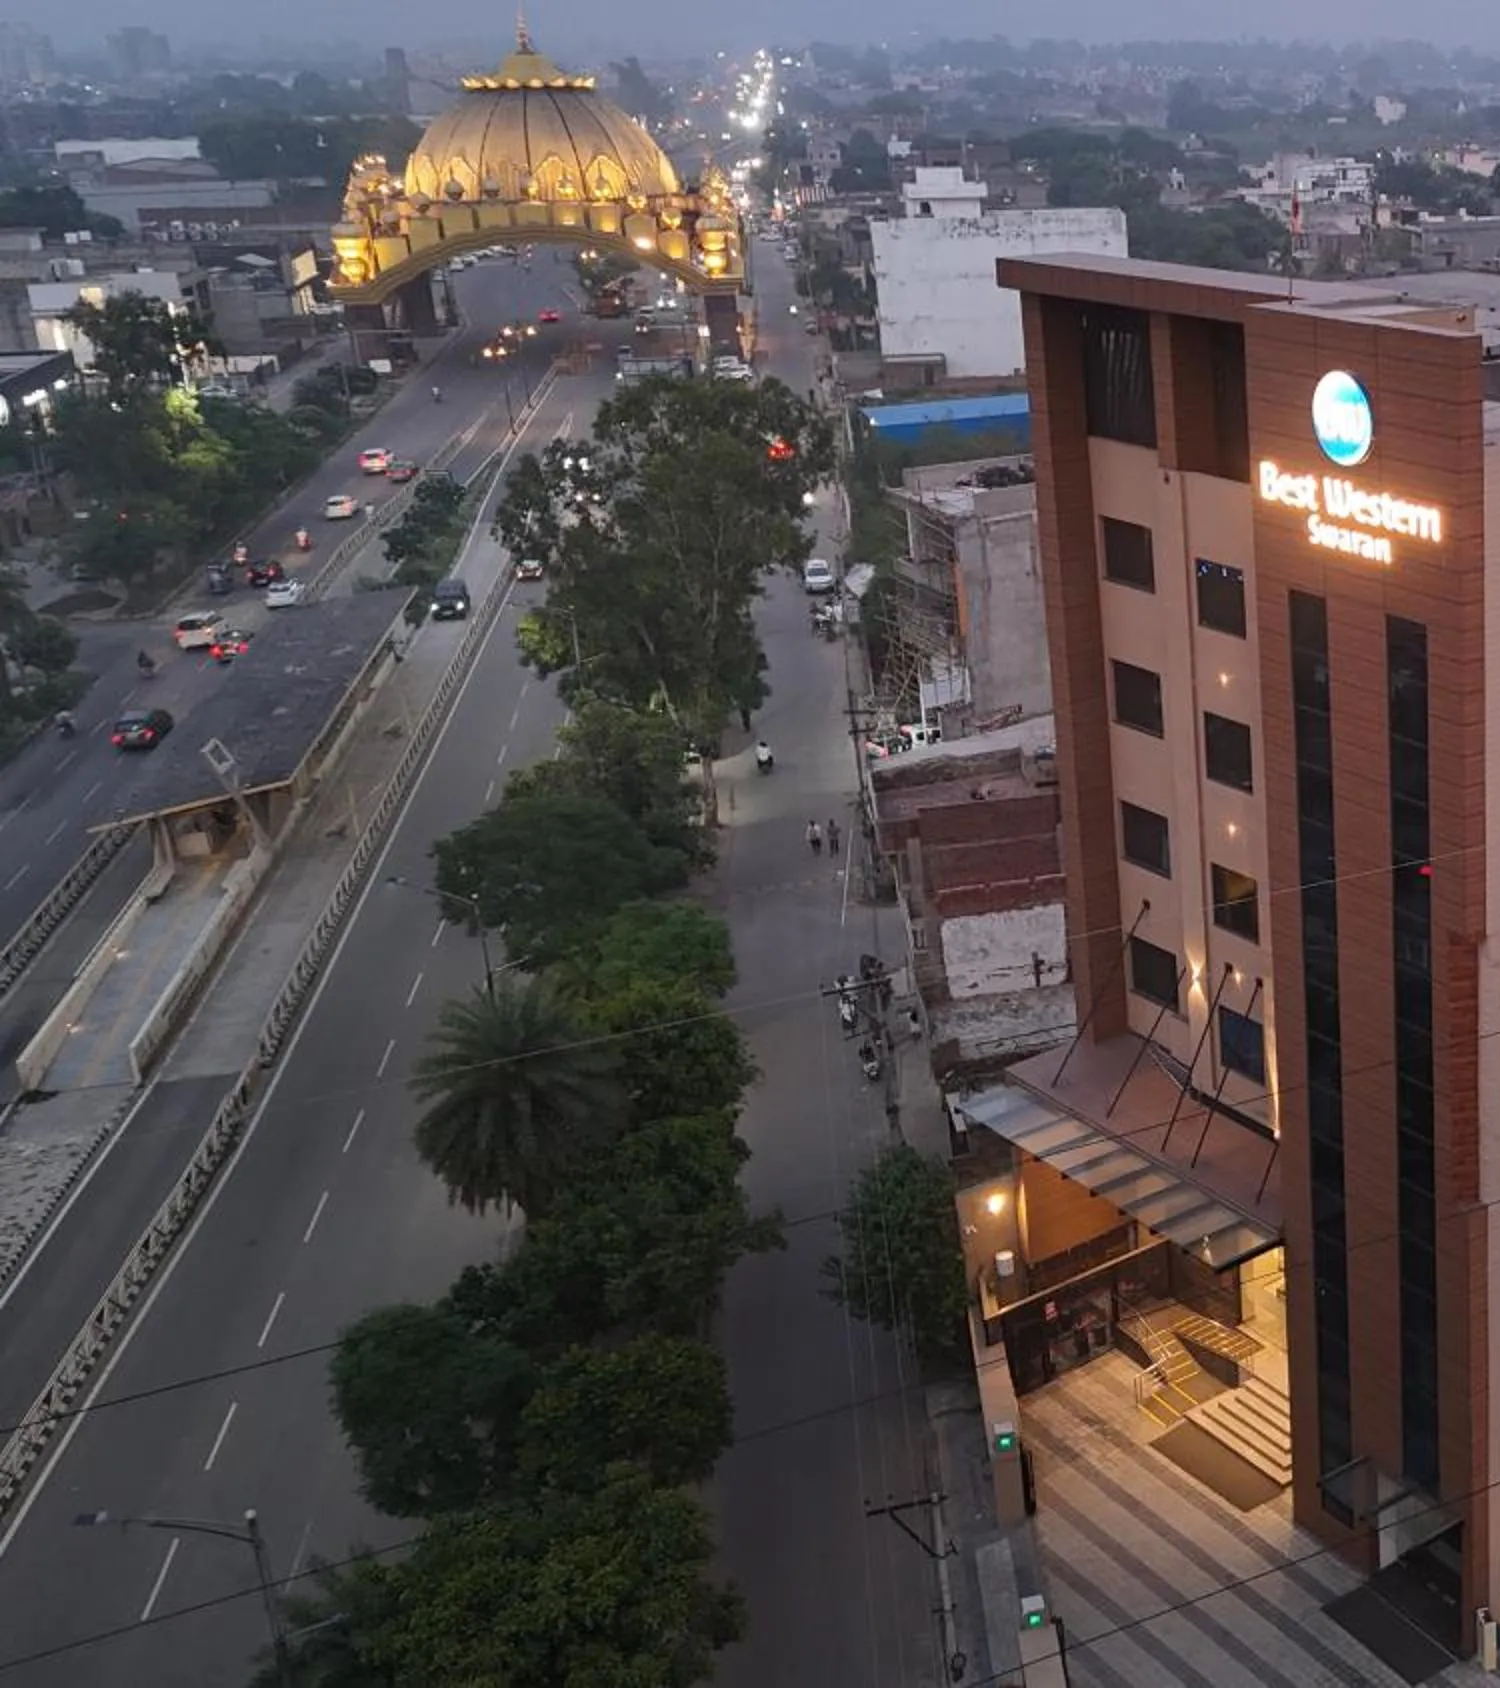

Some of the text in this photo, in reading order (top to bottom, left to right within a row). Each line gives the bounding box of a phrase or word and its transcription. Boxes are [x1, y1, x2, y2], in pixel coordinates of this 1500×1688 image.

[1260, 461, 1440, 542] Best Western
[1307, 514, 1392, 564] Swaran
